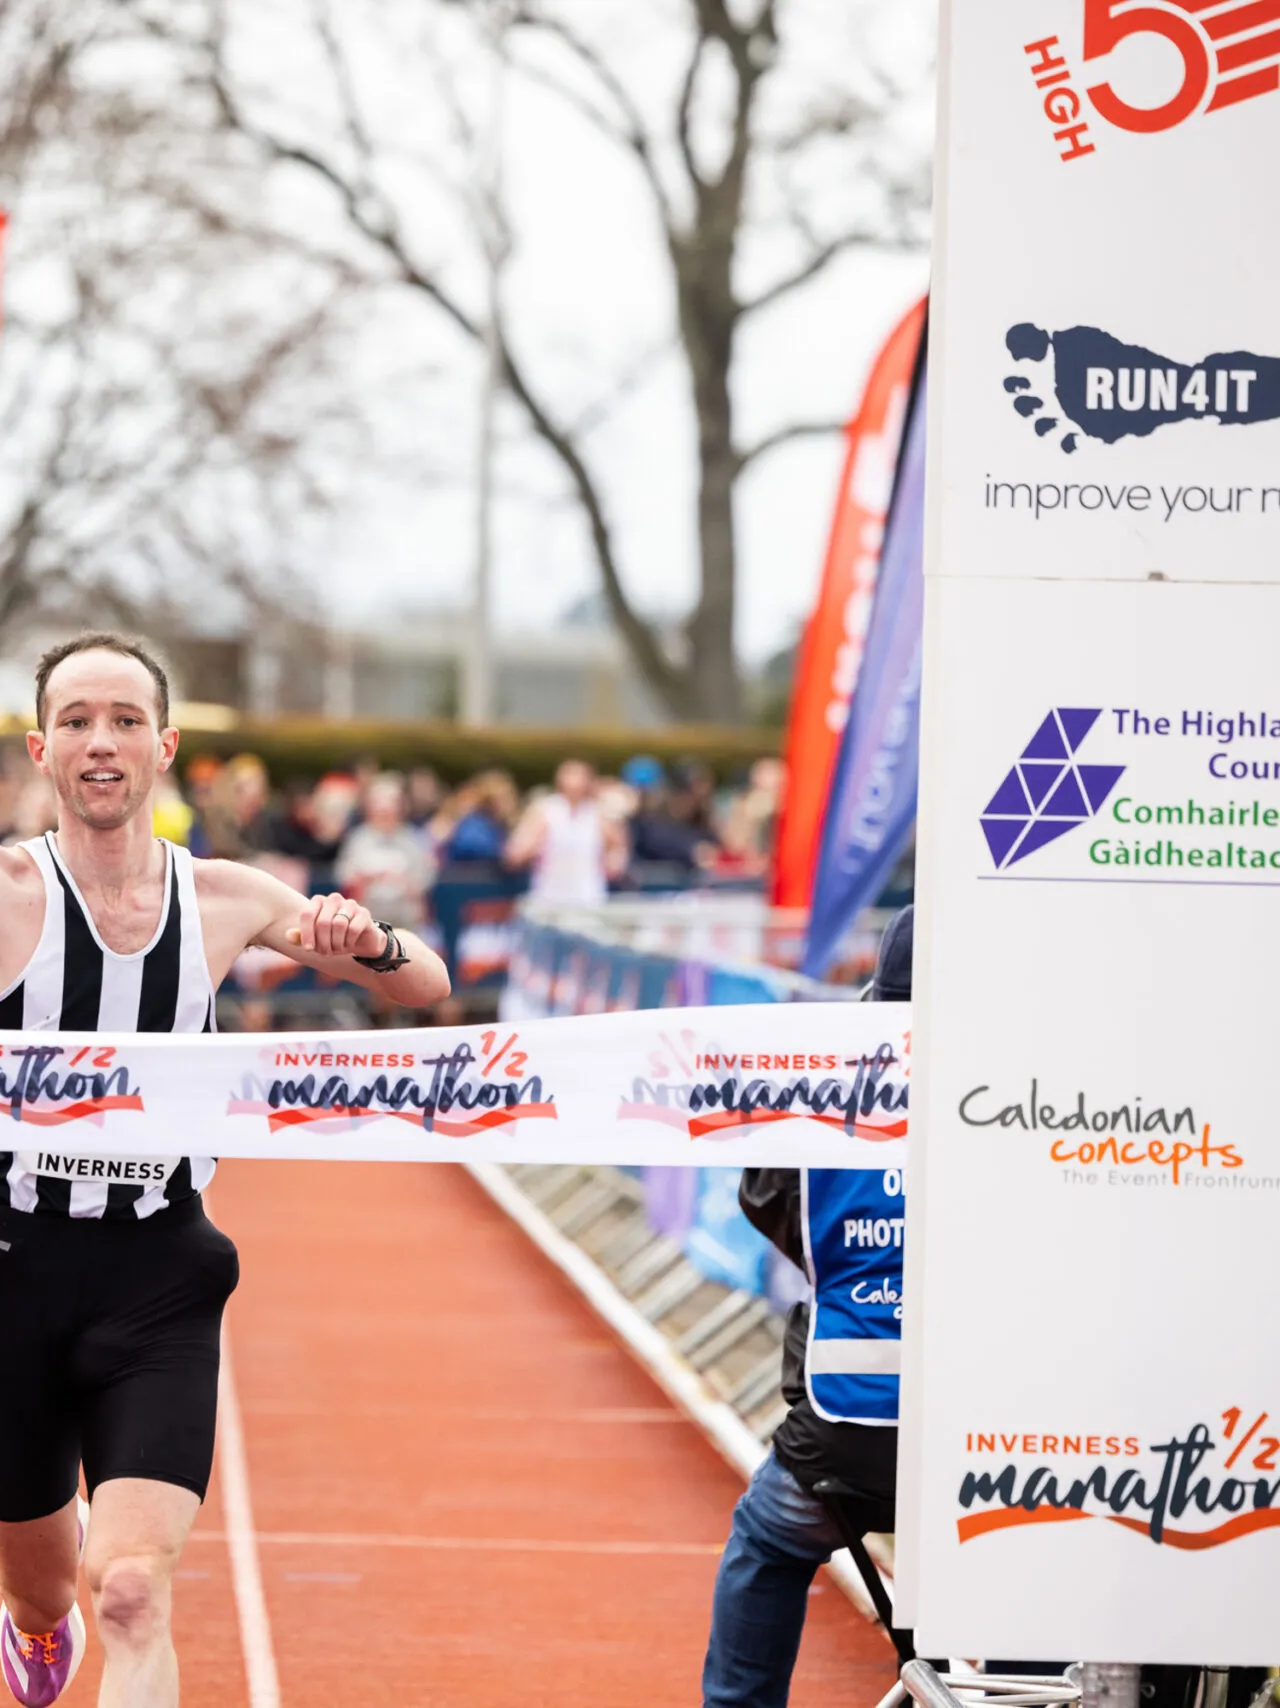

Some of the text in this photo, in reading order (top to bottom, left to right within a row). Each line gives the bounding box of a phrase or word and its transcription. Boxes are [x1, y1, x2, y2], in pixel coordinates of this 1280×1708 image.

[1023, 35, 1096, 162] HIGH
[1085, 366, 1257, 413] RUN4IT
[984, 472, 1152, 521] improve
[1160, 484, 1254, 523] your
[1112, 708, 1171, 736] The
[1112, 797, 1280, 827] Comhairle
[274, 1053, 415, 1068] INVERNESS
[695, 1053, 837, 1070] INVERNESS
[267, 1042, 554, 1133] marathon
[959, 1077, 1196, 1135] Caledonian
[36, 1152, 165, 1180] INVERNESS
[1050, 1123, 1244, 1185] concepts
[1062, 1169, 1099, 1186] The
[1107, 1170, 1168, 1187] Event
[966, 1433, 1139, 1456] INVERNESS
